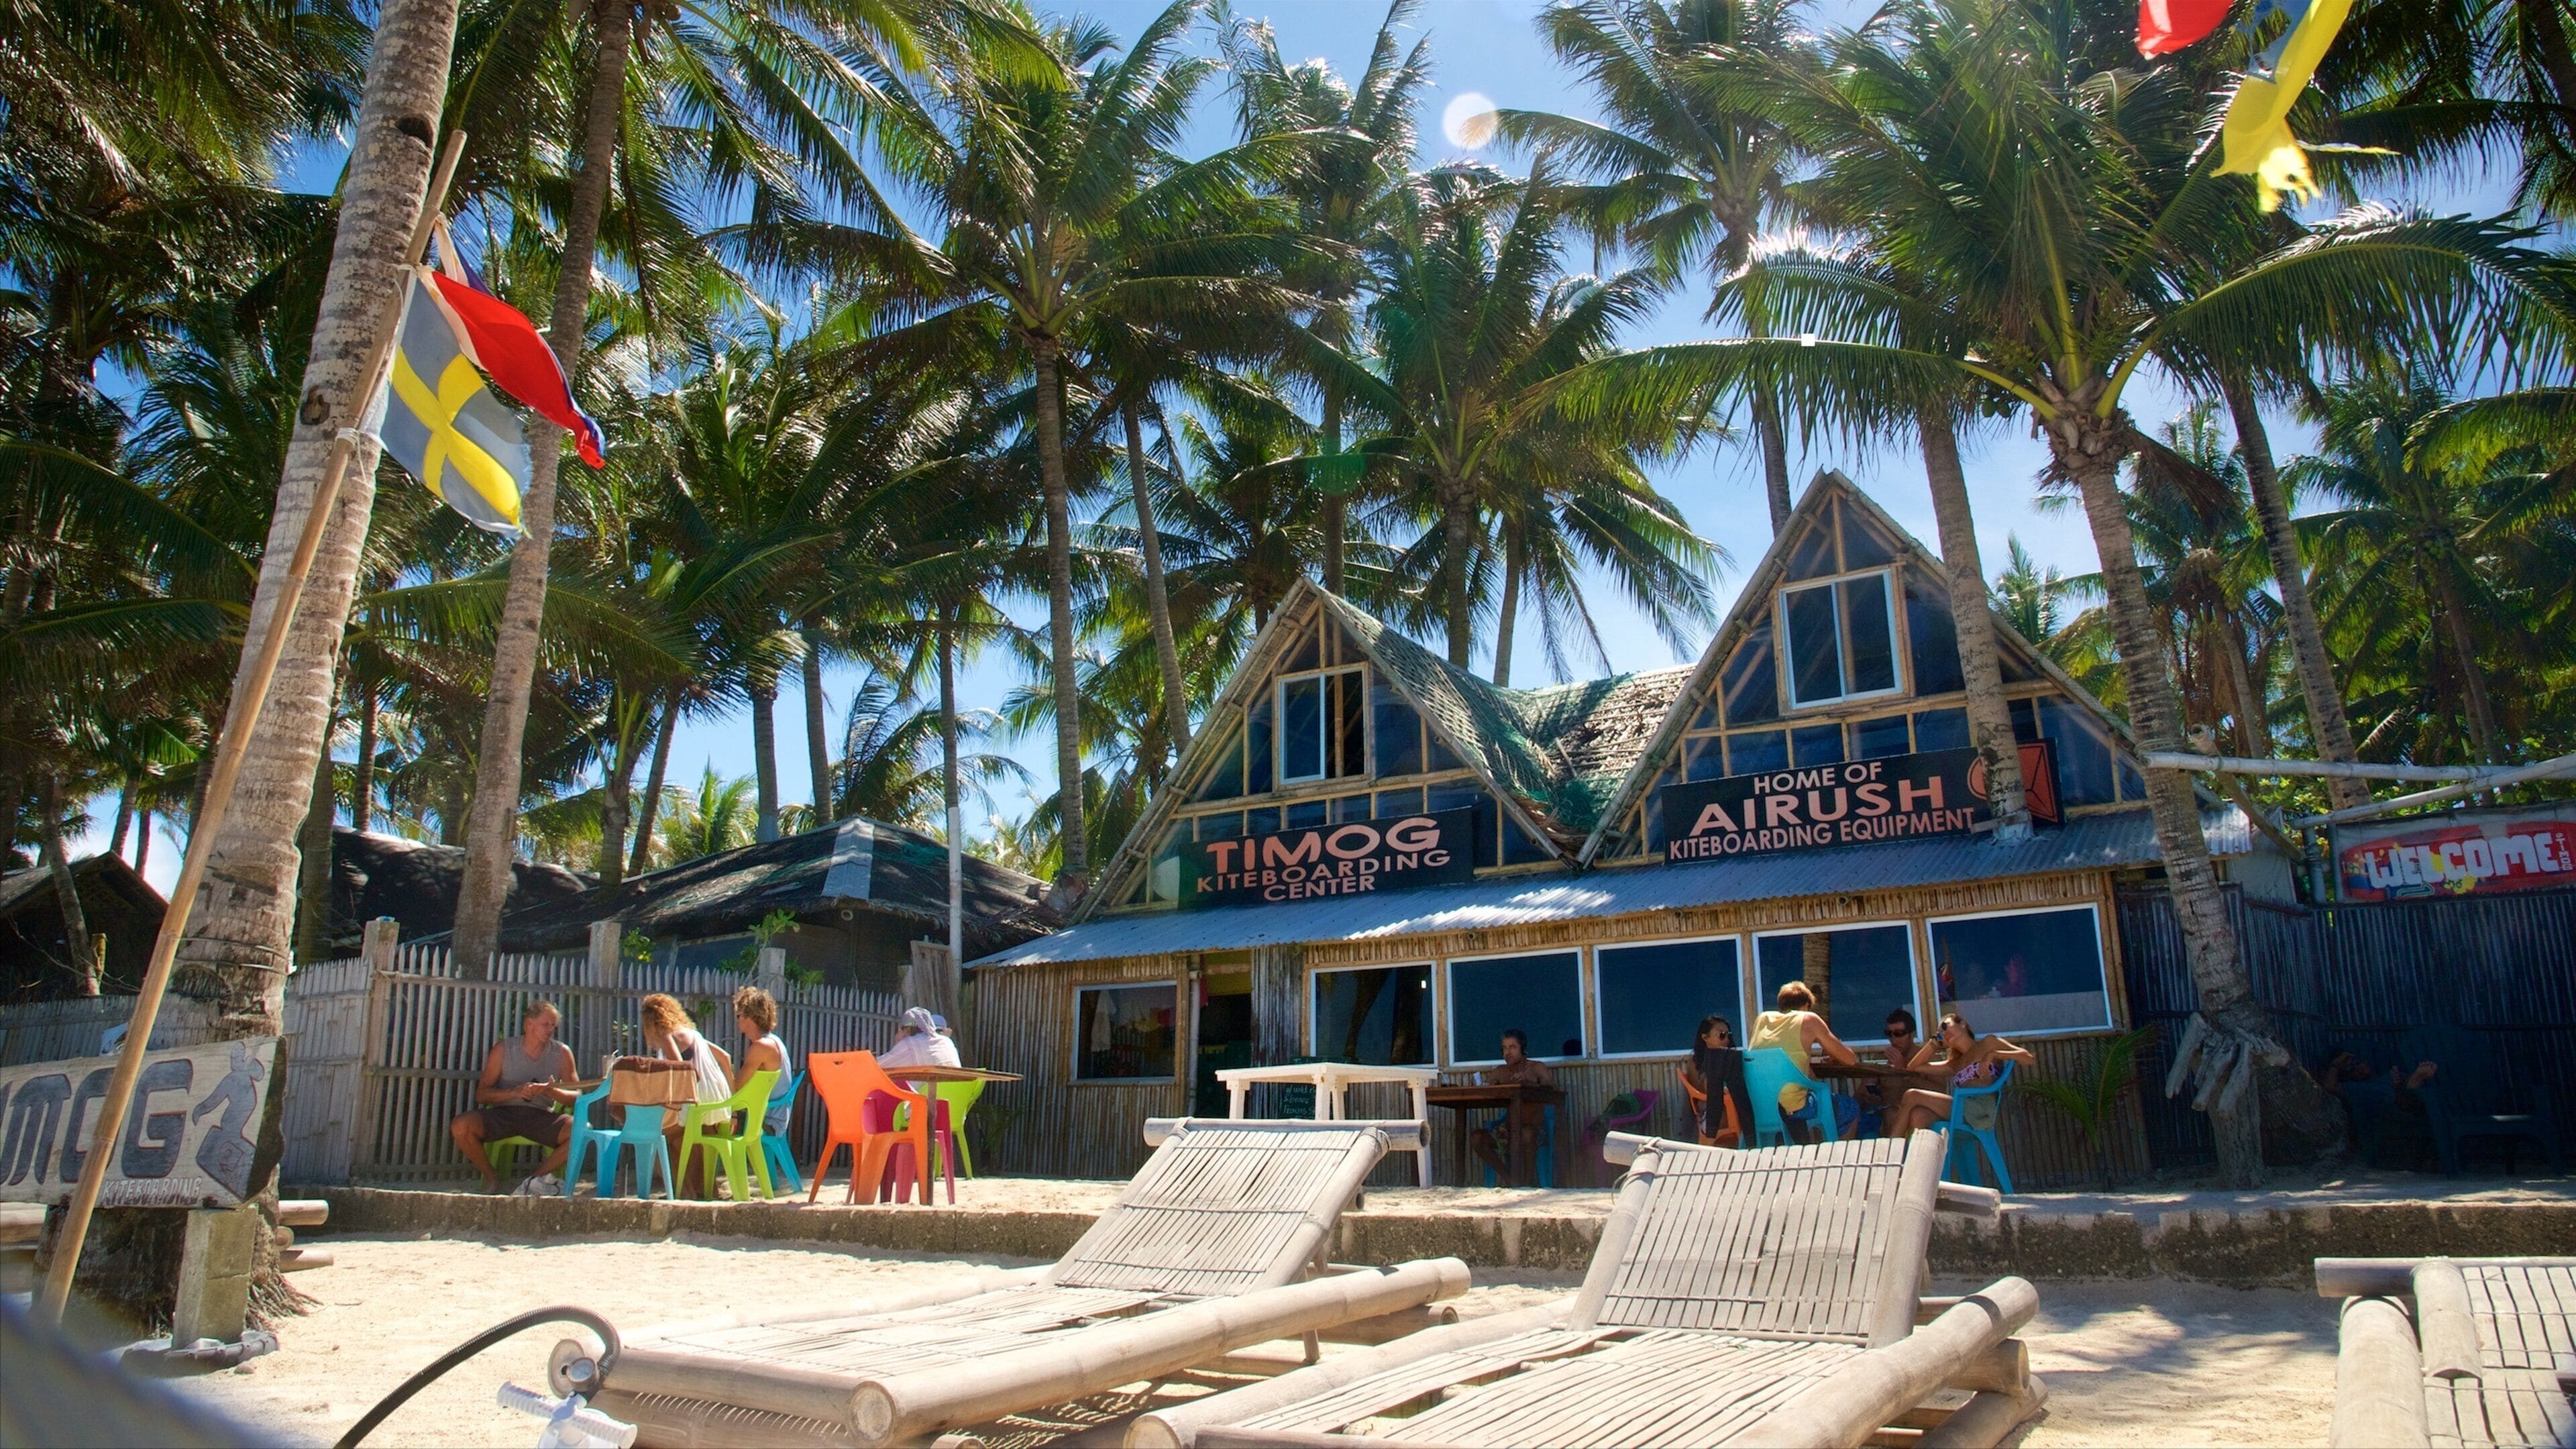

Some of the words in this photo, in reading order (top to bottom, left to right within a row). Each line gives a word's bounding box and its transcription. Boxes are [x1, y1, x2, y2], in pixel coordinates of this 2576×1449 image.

[1754, 767, 1835, 795] HOME
[1844, 761, 1882, 784] OF
[1689, 776, 1945, 837] AIRUSH
[1206, 817, 1440, 874] TIMOG
[1669, 823, 1831, 859] KITEBOARDING
[1840, 808, 1974, 842] EQUIPMENT
[1197, 850, 1450, 894] KITEBOARDING
[2365, 833, 2559, 889] WELCOME
[1264, 875, 1375, 902] CENTER
[101, 1177, 202, 1199] KITEBOARDING
